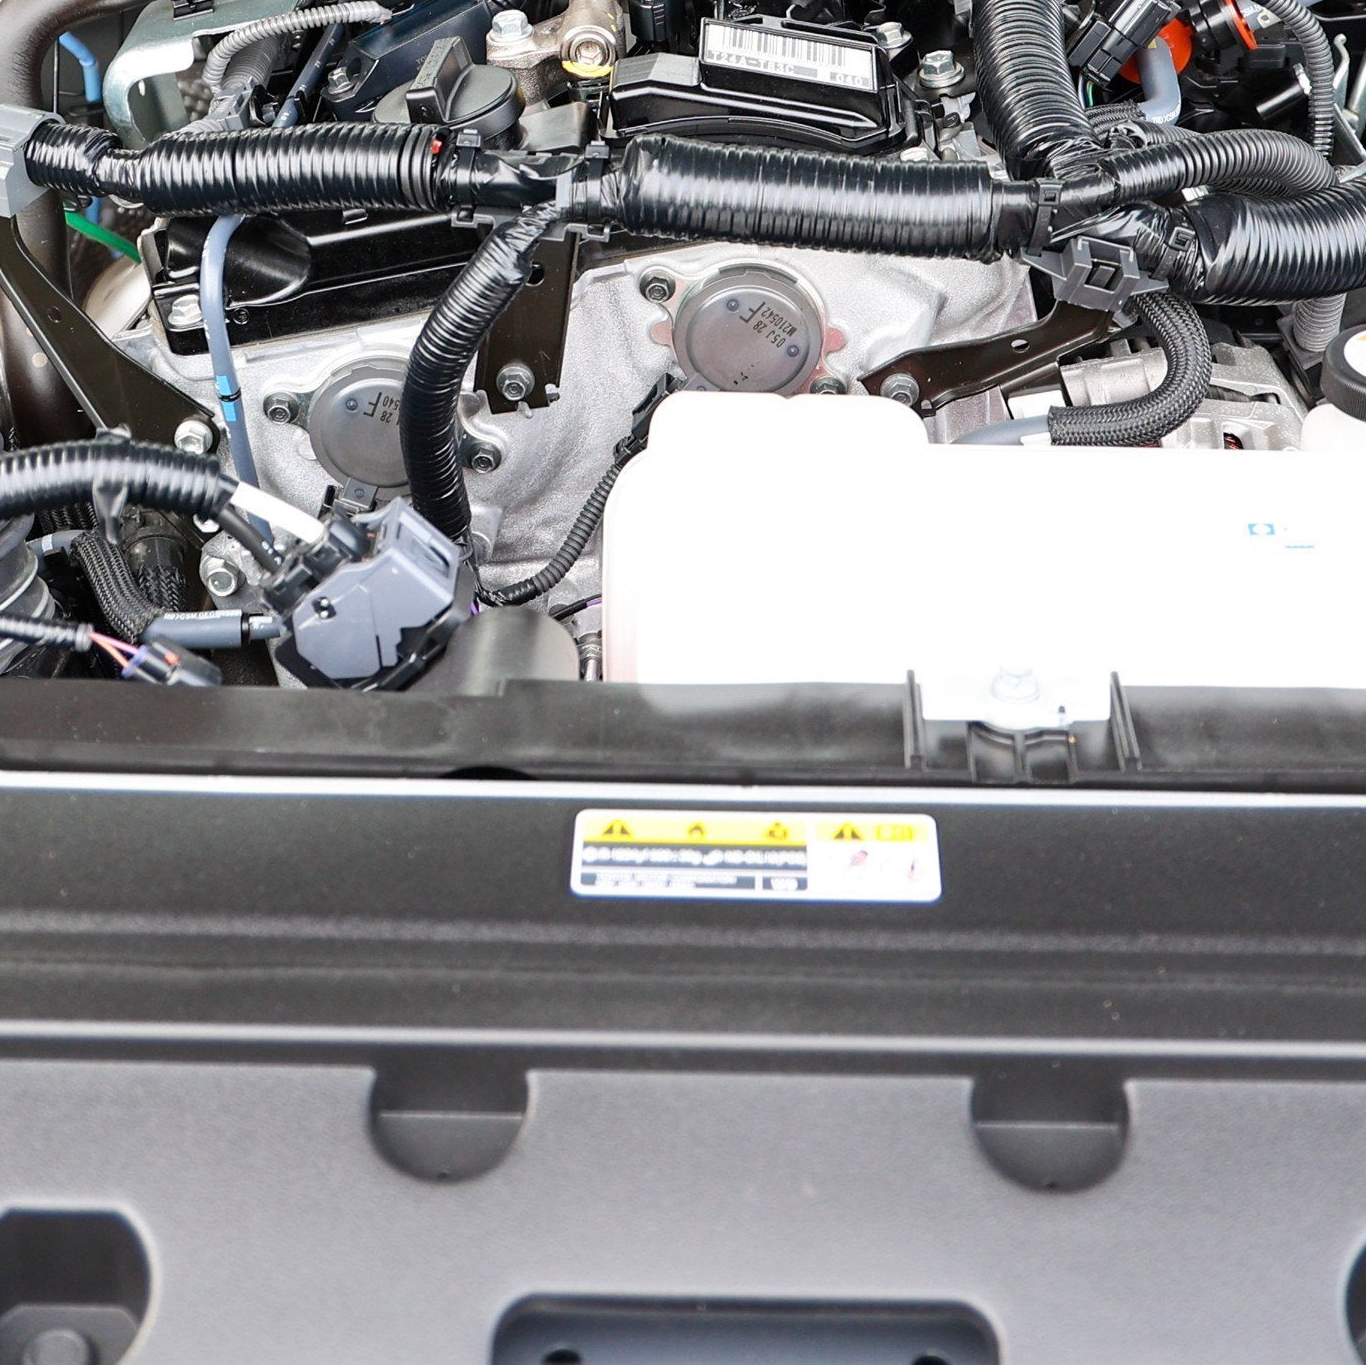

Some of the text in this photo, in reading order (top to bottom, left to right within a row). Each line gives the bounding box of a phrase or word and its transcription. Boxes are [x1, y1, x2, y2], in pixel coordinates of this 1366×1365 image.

[737, 295, 767, 325] F
[759, 302, 798, 341] M210542
[751, 318, 768, 335] 28
[361, 387, 383, 419] F
[378, 409, 394, 424] 28
